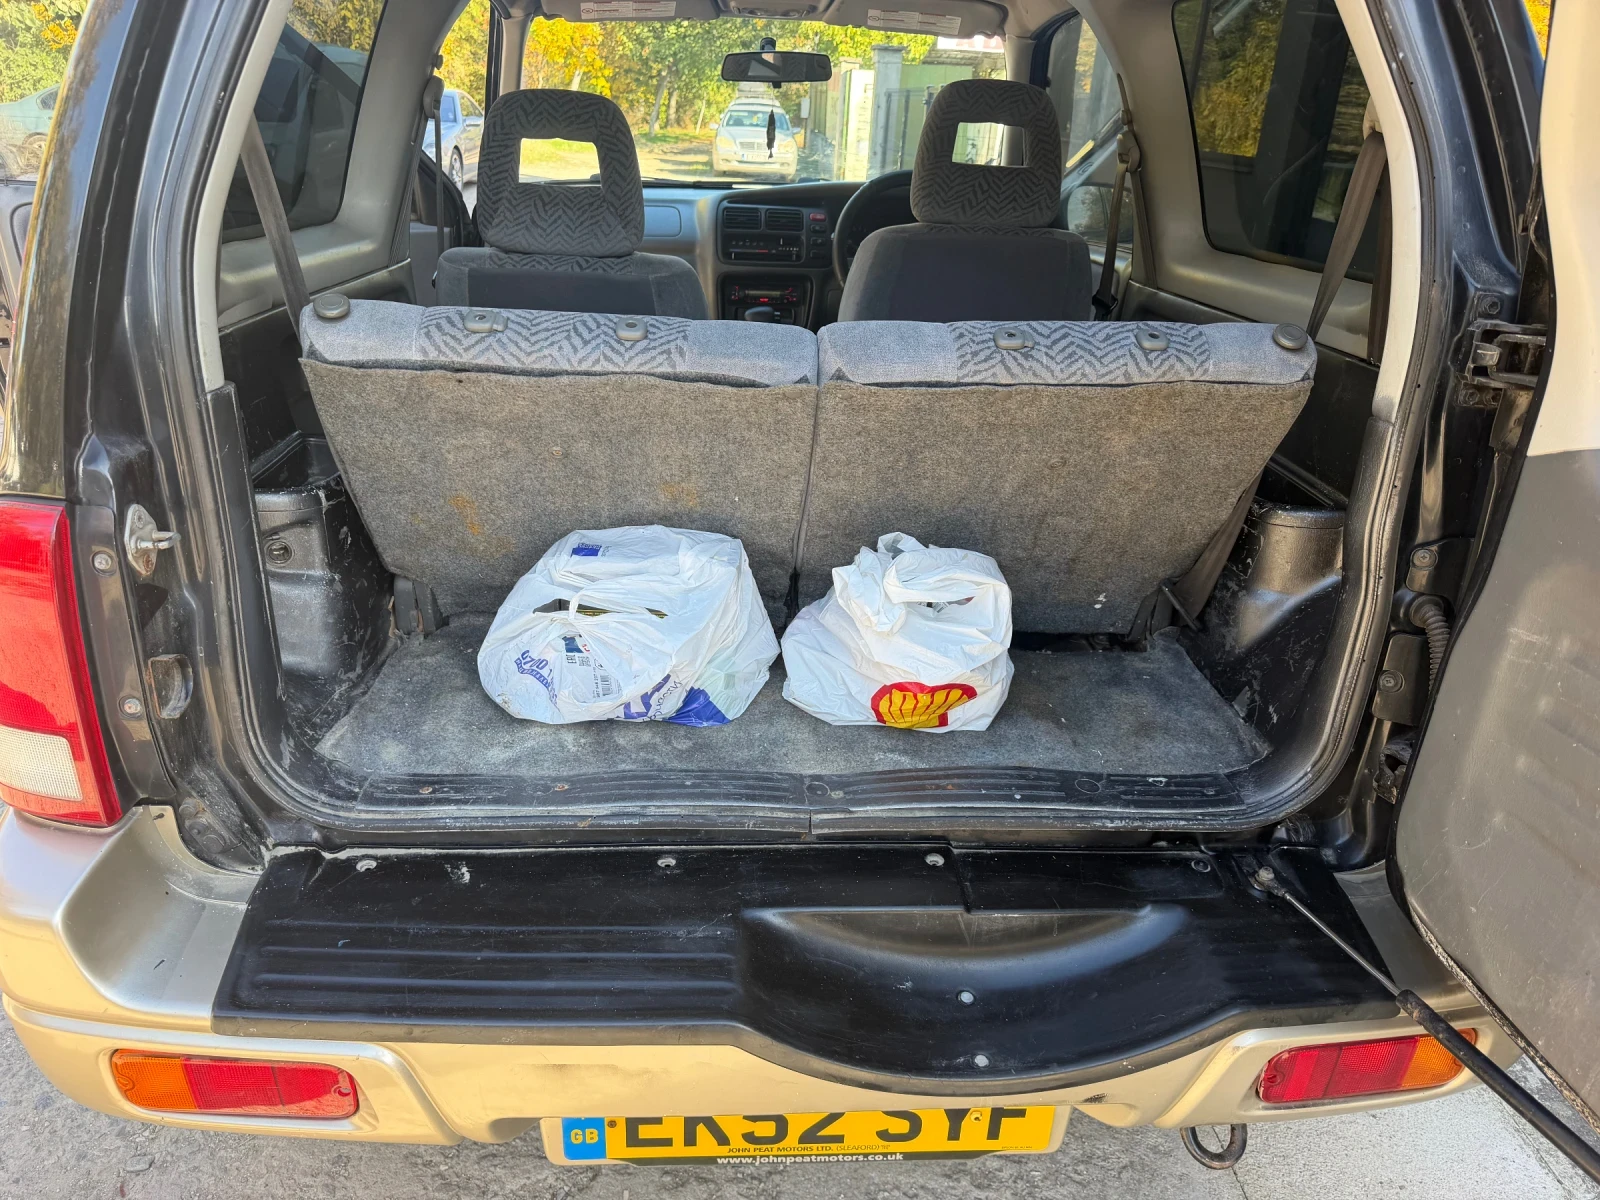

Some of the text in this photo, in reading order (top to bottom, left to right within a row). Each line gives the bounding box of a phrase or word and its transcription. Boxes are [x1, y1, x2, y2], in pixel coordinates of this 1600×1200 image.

[570, 1128, 599, 1144] GB
[727, 1146, 751, 1154] JOHN
[836, 1144, 880, 1152] (SLEAFORD)
[716, 1152, 904, 1166] www.johnpeatmotors.co.uk
